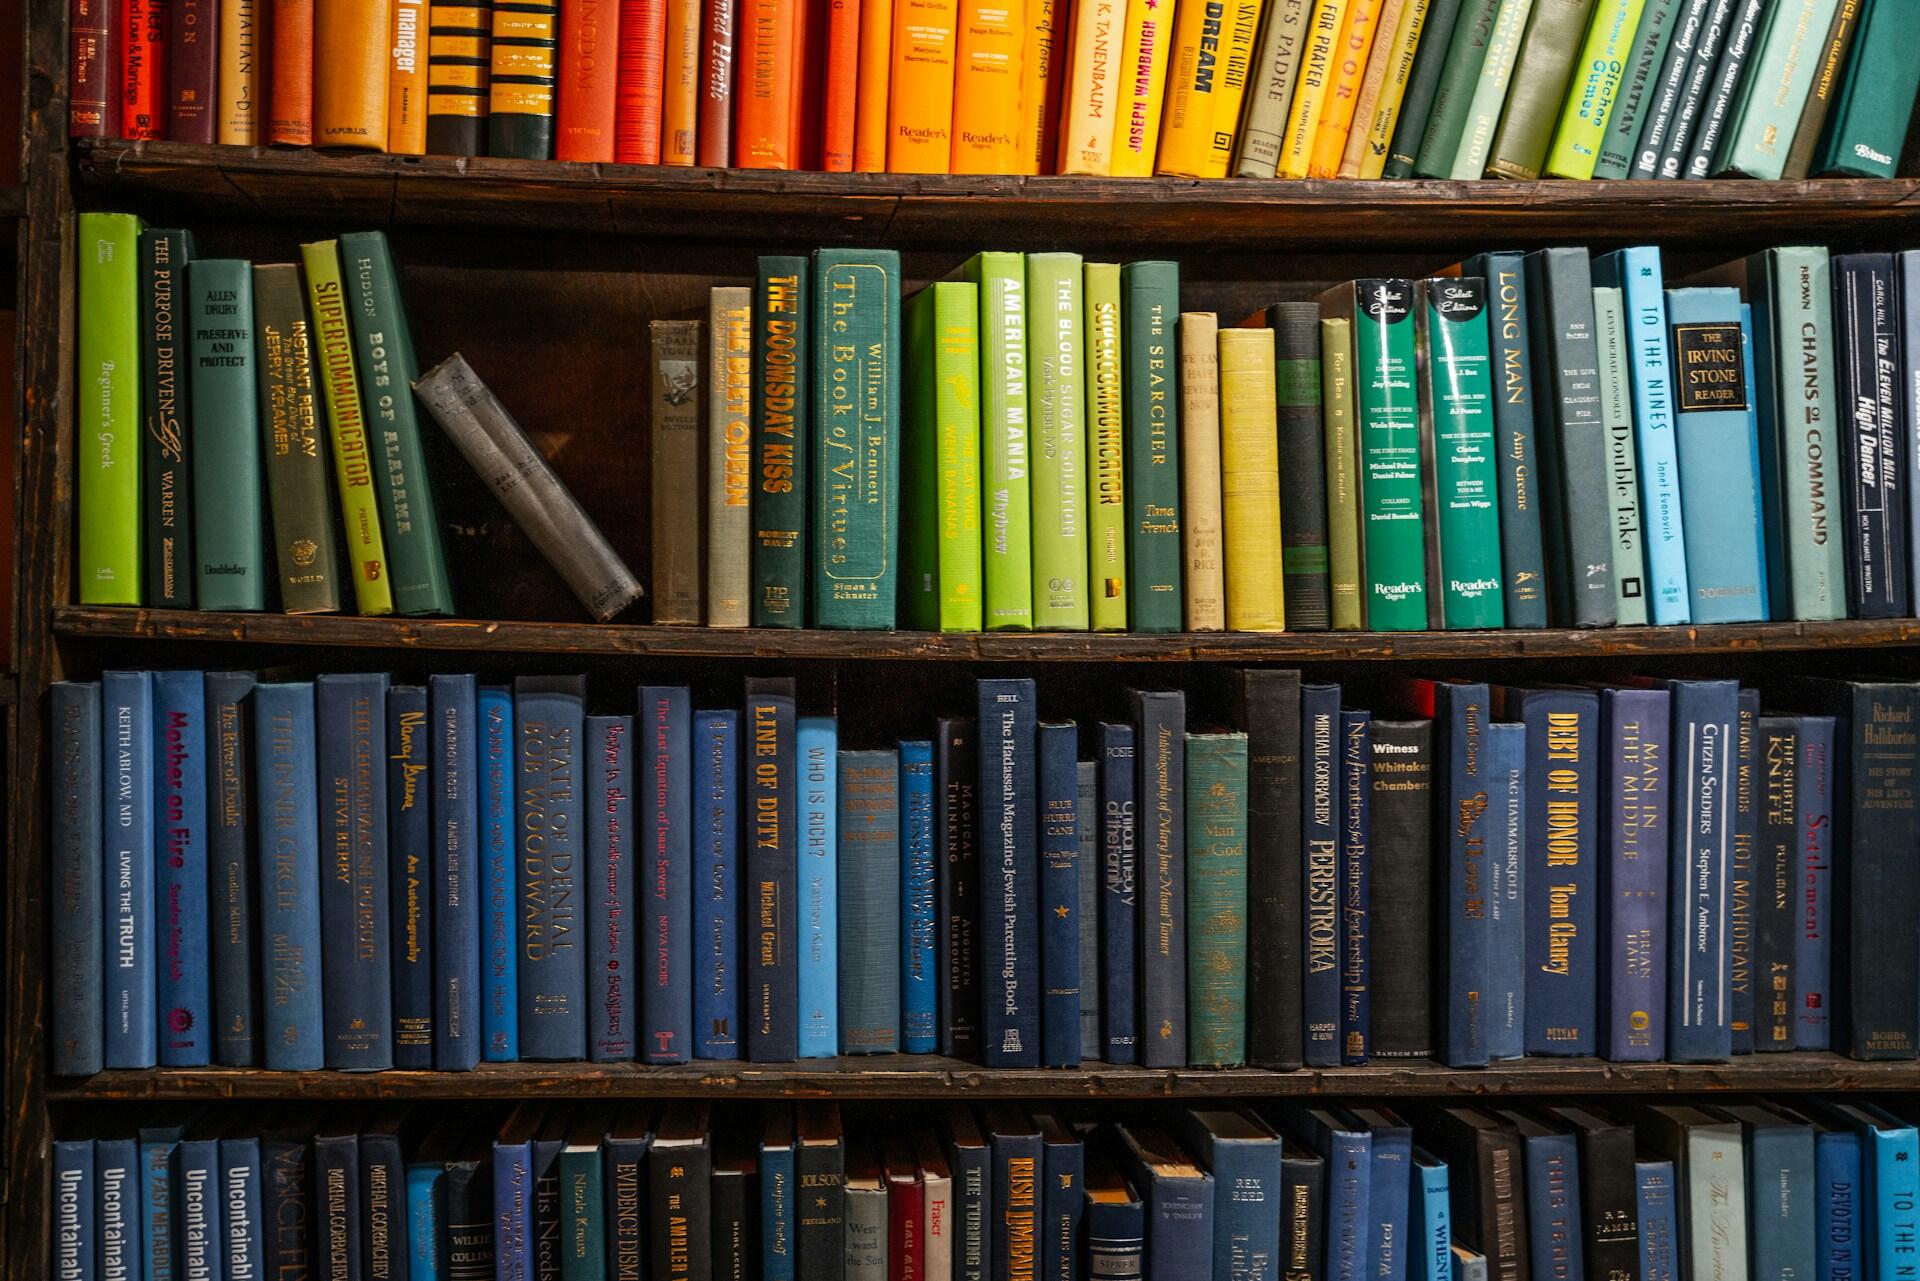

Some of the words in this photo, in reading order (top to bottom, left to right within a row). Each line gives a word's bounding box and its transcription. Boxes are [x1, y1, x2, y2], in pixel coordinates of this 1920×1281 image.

[128, 16, 140, 42] Love
[1097, 2, 1109, 16] K.
[1230, 3, 1256, 45] SISTER
[1320, 4, 1337, 30] FOR
[1411, 14, 1419, 25] in
[1654, 9, 1666, 25] in
[129, 45, 139, 54] &
[393, 9, 418, 73] manager
[1195, 2, 1223, 92] DREAM
[1405, 30, 1418, 47] the
[1675, 16, 1698, 53] County
[710, 41, 731, 101] Heretic
[754, 18, 775, 98] KELLERMAN
[1089, 20, 1111, 117] TANENBAUM
[1134, 21, 1157, 96] WAMBAUGH
[1224, 46, 1251, 88] CARRIE
[1268, 35, 1293, 100] PADRE
[1306, 36, 1331, 87] PRAYER
[1396, 51, 1413, 84] House
[1666, 56, 1684, 86] ROBERT
[125, 56, 140, 105] Marriage
[1579, 59, 1605, 118] Gumee
[1592, 60, 1622, 126] Gitchee
[1619, 32, 1661, 136] MANHATTAN
[1658, 88, 1674, 112] JAMES
[900, 126, 946, 139] Reader's
[963, 132, 1010, 144] Reader's
[1128, 102, 1145, 152] JOSEPH
[1293, 101, 1311, 156] TEMPLEGATE
[1650, 114, 1667, 145] WALLER
[207, 290, 237, 301] ALLEN
[767, 275, 798, 314] THE
[832, 275, 856, 333] The
[1499, 271, 1521, 339] LONG
[1800, 266, 1812, 310] BROWN
[1876, 280, 1885, 306] CAROL
[205, 305, 238, 315] DRURY
[726, 306, 751, 353] THE
[1151, 305, 1163, 335] THE
[1605, 310, 1616, 336] KEVIN
[1641, 307, 1659, 325] TO
[1877, 309, 1886, 326] HILL
[197, 329, 248, 340] PRESERVE
[211, 343, 233, 353] AND
[1004, 277, 1023, 396] AMERICAN
[1644, 337, 1662, 367] THE
[1702, 333, 1722, 343] THE
[1878, 338, 1888, 355] The
[200, 357, 246, 367] PROTECT
[1334, 352, 1345, 373] For
[1504, 348, 1524, 405] MAN
[1608, 337, 1619, 375] MICHAEL
[1688, 349, 1736, 363] IRVING
[1690, 369, 1737, 384] STONE
[1801, 323, 1819, 400] CHAINS
[97, 361, 115, 427] Beginner's
[315, 282, 370, 488] SUPERCOMMUNICATOR
[725, 356, 750, 416] BEET
[764, 319, 796, 438] DOOMSDAY
[832, 345, 856, 415] Book
[1335, 377, 1345, 399] Bea
[1610, 376, 1622, 420] CONNOLLY
[1695, 389, 1734, 400] READER
[1878, 359, 1895, 404] ELEVEN
[1149, 346, 1166, 465] SEARCHER
[1646, 380, 1667, 431] NINES
[1856, 395, 1877, 432] High
[99, 432, 114, 469] Greek
[825, 426, 854, 454] of
[1007, 406, 1024, 480] MANIA
[1881, 407, 1895, 456] MILLION
[724, 421, 748, 506] QUEEN
[762, 444, 793, 493] KISS
[1611, 426, 1637, 496] Double
[1860, 434, 1878, 487] Dancer
[1883, 459, 1896, 489] MILE
[160, 471, 174, 526] WARREN
[1807, 430, 1828, 545] COMMAND
[832, 460, 855, 564] Virtues
[1617, 501, 1637, 550] Take
[834, 583, 864, 591] Simon
[870, 583, 877, 591] &
[1375, 582, 1422, 595] Reader's
[1451, 579, 1498, 592] Reader's
[118, 707, 132, 748] KEITH
[657, 698, 670, 721] The
[754, 705, 777, 756] LINE
[1002, 710, 1015, 737] The
[165, 711, 189, 791] Mother
[657, 725, 669, 755] Last
[1373, 744, 1419, 753] Witness
[1546, 713, 1578, 762] DEBT
[1782, 735, 1794, 765] THE
[117, 750, 132, 801] ABLOW,
[655, 758, 669, 808] Equation
[756, 763, 777, 789] OF
[808, 747, 826, 782] WHO
[1002, 739, 1016, 801] Hadassah
[1509, 769, 1519, 795] DAG
[1546, 769, 1578, 794] OF
[120, 804, 132, 827] MD
[168, 795, 182, 821] on
[657, 810, 670, 823] of
[808, 790, 826, 804] IS
[1782, 769, 1794, 825] SUBTLE
[658, 826, 670, 855] Isaac
[756, 797, 779, 849] DUTY
[808, 813, 826, 858] RICH?
[947, 782, 960, 862] THINKING
[999, 803, 1016, 866] Magazine
[1546, 800, 1579, 867] HONOR
[168, 828, 189, 868] Fire
[407, 855, 419, 873] An
[1506, 798, 1519, 900] HAMMARSKJOLD
[1696, 848, 1711, 890] Stephen
[120, 850, 131, 889] LIVING
[654, 859, 669, 899] Severy
[1000, 868, 1017, 912] Jewish
[1775, 844, 1786, 910] PULLMAN
[1804, 813, 1830, 941] Settlement
[120, 891, 131, 913] THE
[1309, 839, 1336, 973] PERESTROIKA
[1548, 883, 1576, 918] Tom
[1698, 893, 1710, 903] E.
[405, 877, 420, 963] Autobiography
[1696, 906, 1710, 953] Ambrose
[120, 915, 134, 968] TRUTH
[1000, 915, 1017, 978] Parenting
[1542, 922, 1577, 976] Clancy
[1003, 980, 1017, 1016] Book
[371, 1165, 387, 1211] MIKHAIL
[617, 1163, 638, 1236] EVIDENCE
[669, 1194, 680, 1209] THE
[801, 1174, 840, 1187] JOLSON
[967, 1167, 981, 1195] THE
[1009, 1158, 1034, 1206] RUSH
[1232, 1192, 1265, 1201] REED
[1236, 1179, 1261, 1188] REX
[1780, 1169, 1790, 1217] Lanchester
[1894, 1192, 1914, 1210] TO
[932, 1200, 945, 1237] Fraser
[966, 1201, 981, 1265] TURNING
[1832, 1182, 1851, 1243] DEVOTED
[372, 1212, 388, 1279] GORBACHEV
[1381, 1224, 1392, 1275] Wicked
[1435, 1225, 1448, 1273] WHEN
[1832, 1249, 1851, 1262] IN
[1895, 1223, 1915, 1253] THE
